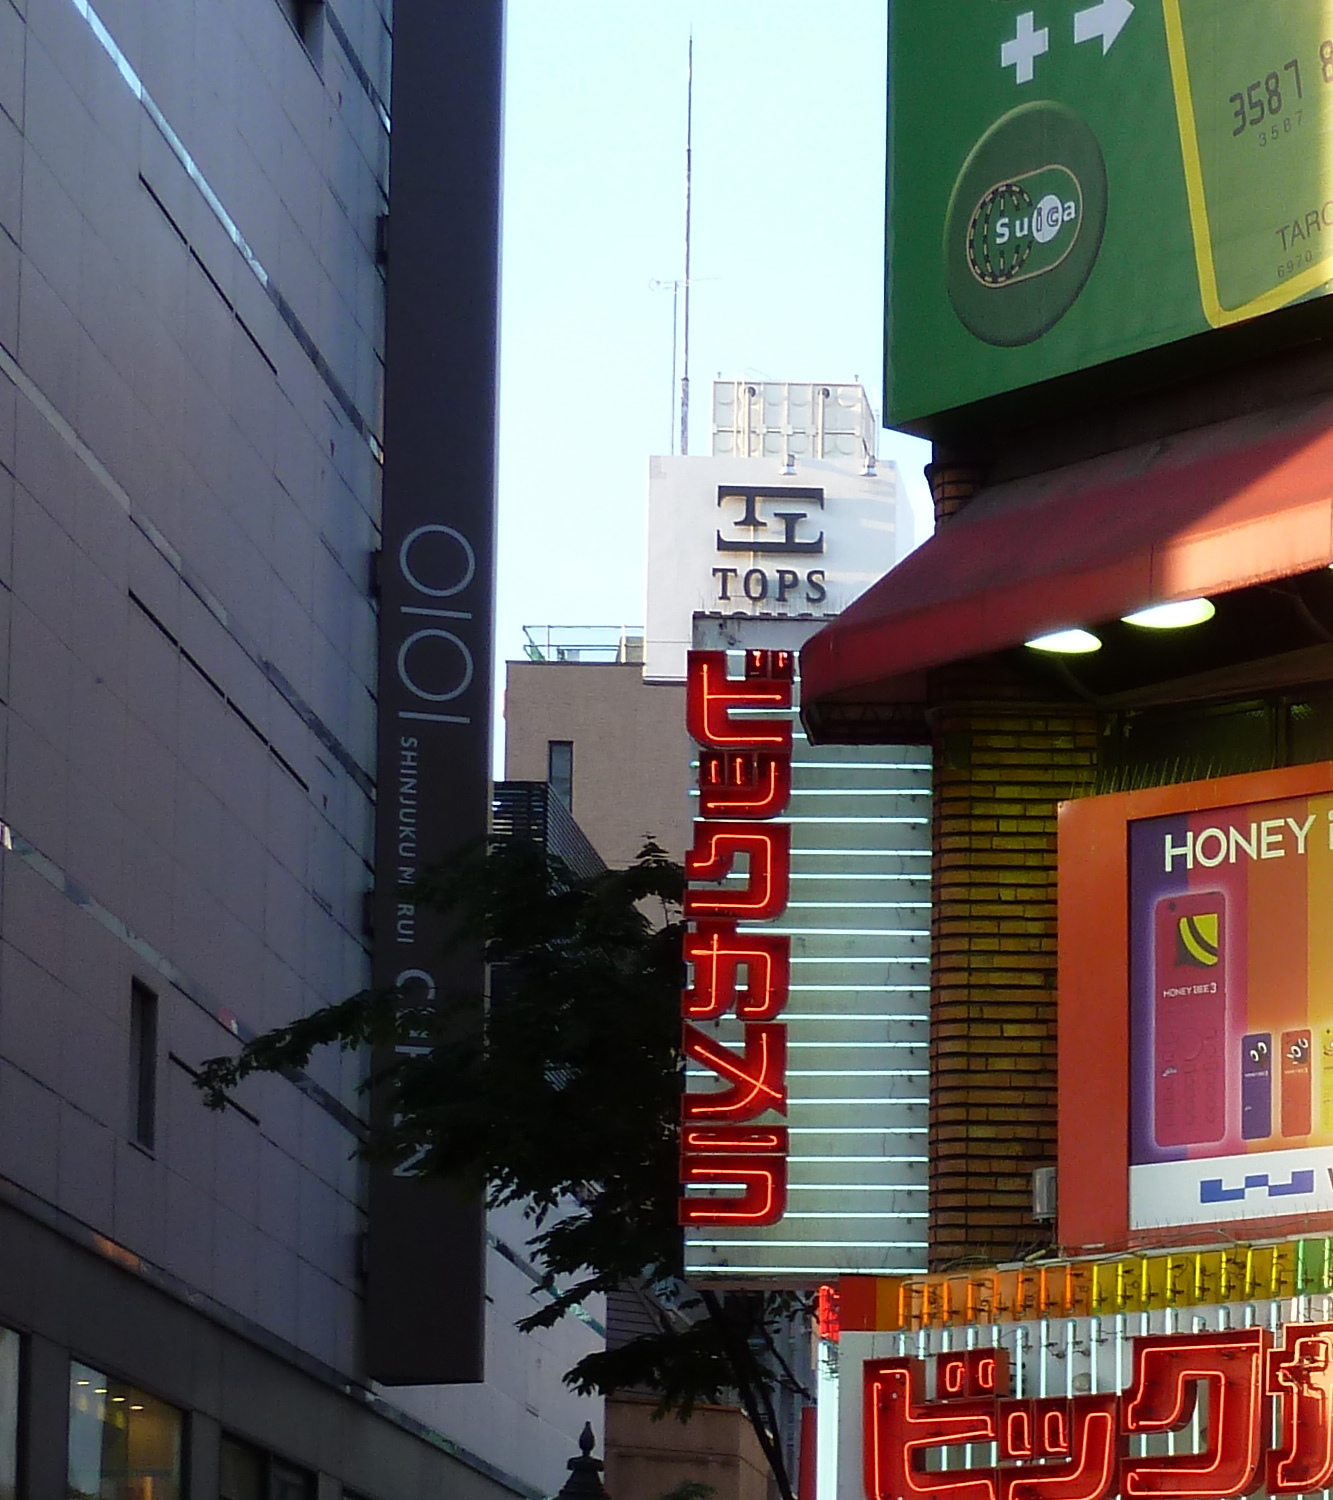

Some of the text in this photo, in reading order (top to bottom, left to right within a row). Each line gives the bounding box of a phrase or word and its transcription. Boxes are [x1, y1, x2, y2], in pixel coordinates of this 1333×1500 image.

[1229, 58, 1304, 138] 3587
[1257, 110, 1304, 148] 3587
[994, 194, 1076, 246] Suica
[712, 567, 827, 603] TOPS
[399, 736, 418, 866] SHINJUKU
[1164, 813, 1318, 873] HONEY
[684, 648, 797, 1228] ビックカメラ
[1164, 987, 1193, 999] HONEY
